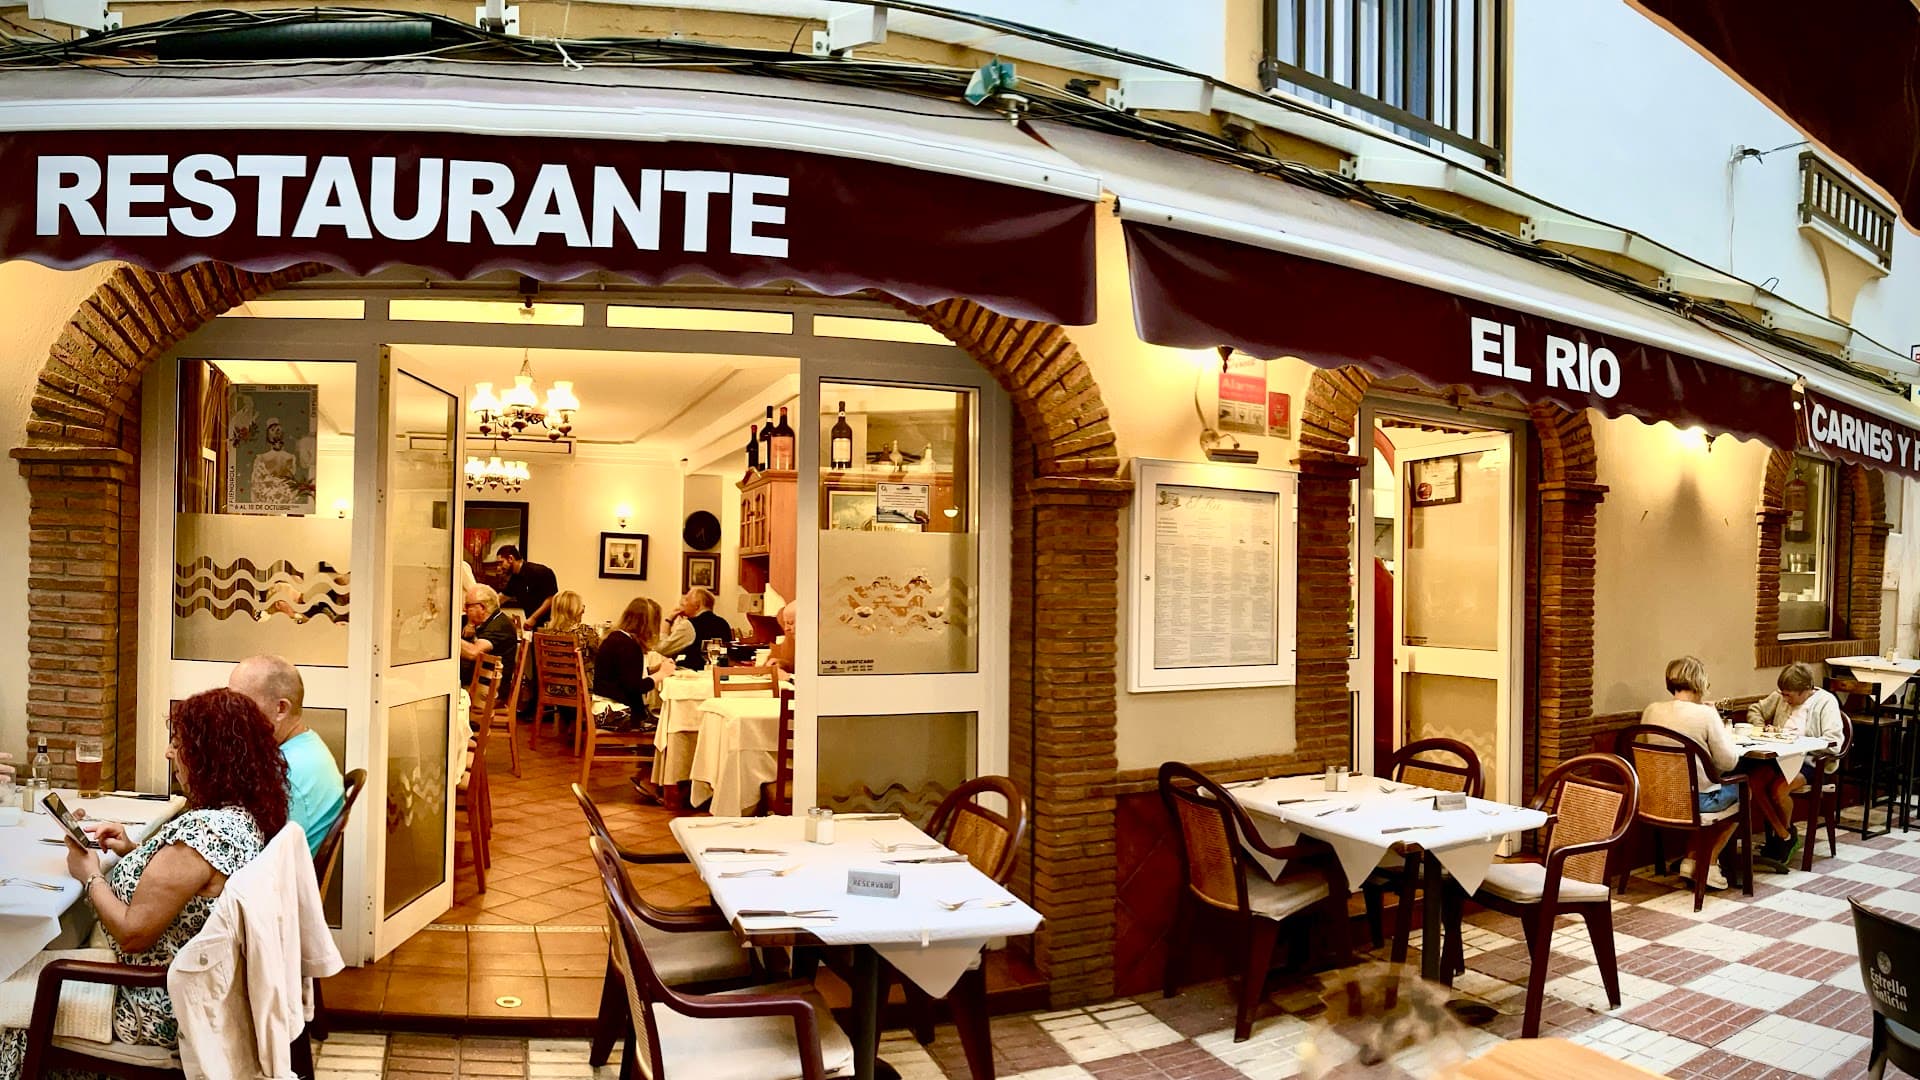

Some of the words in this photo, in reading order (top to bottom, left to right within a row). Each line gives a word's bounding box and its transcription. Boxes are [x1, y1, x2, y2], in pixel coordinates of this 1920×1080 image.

[36, 154, 790, 258] RESTAURANTE
[1471, 317, 1532, 382] EL
[1546, 335, 1621, 398] RIO
[1812, 403, 1893, 463] CARNES
[1897, 434, 1910, 468] Y
[1870, 967, 1907, 997] Estrella
[1872, 983, 1907, 1012] Galicia
